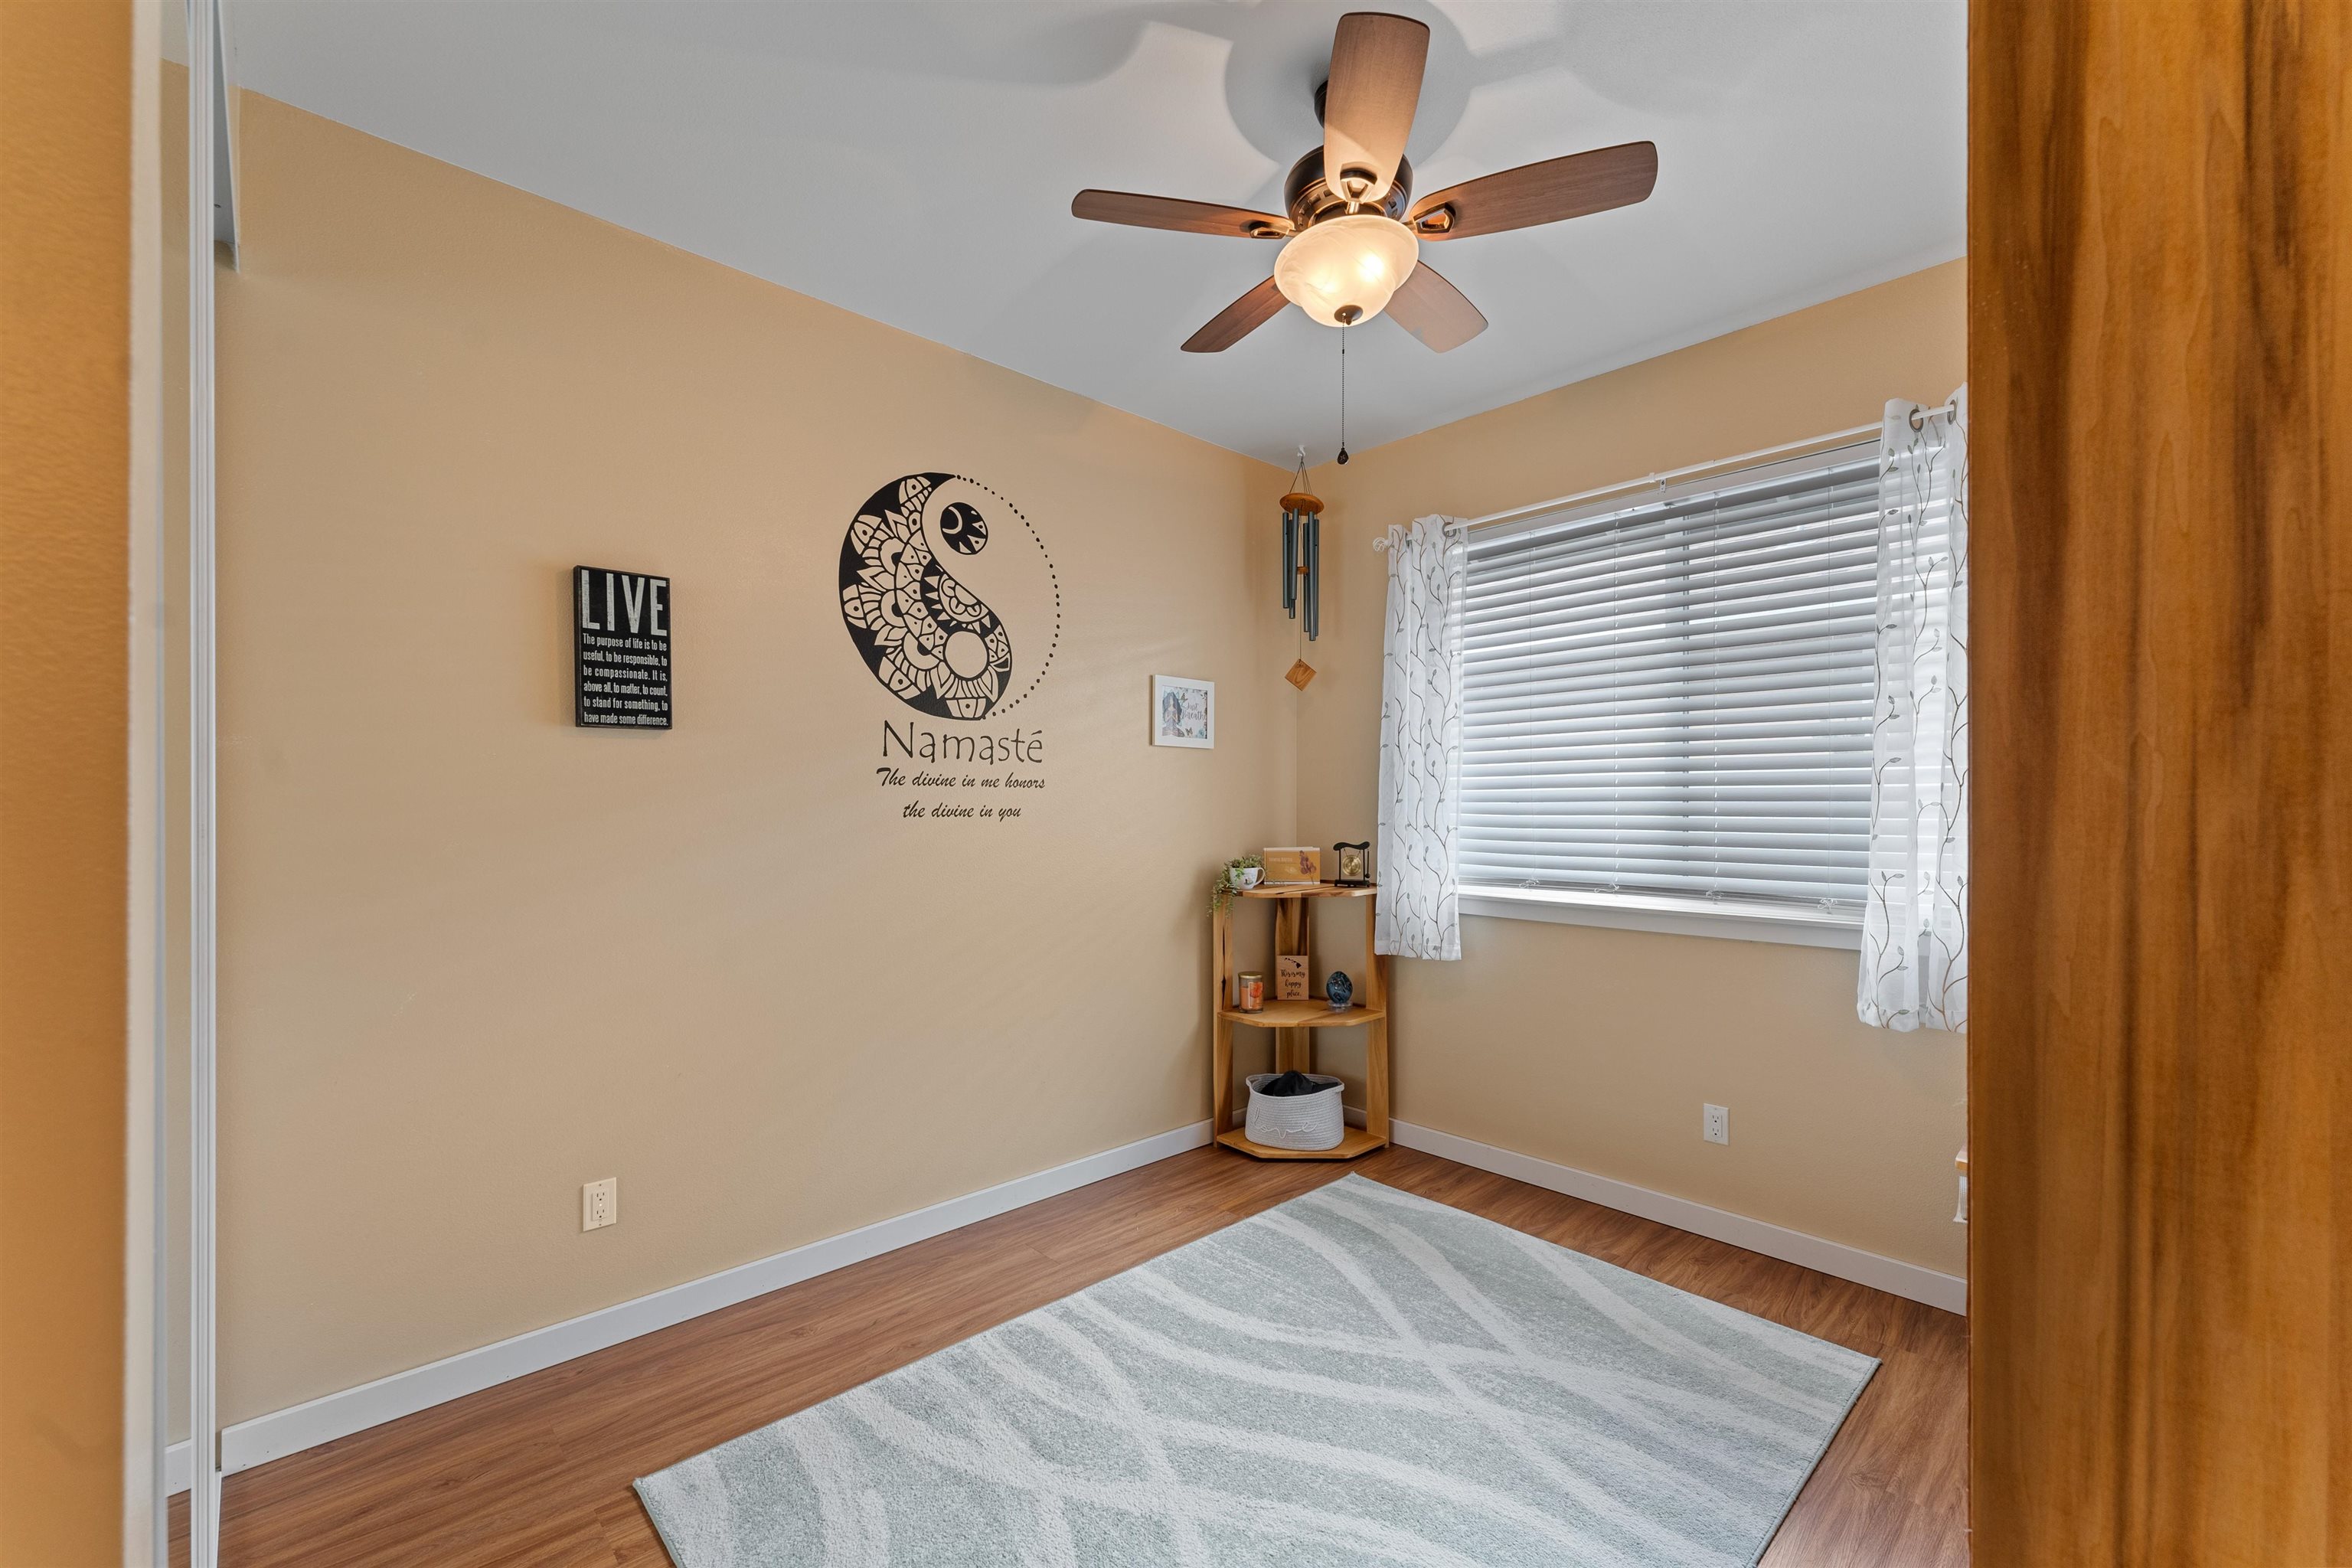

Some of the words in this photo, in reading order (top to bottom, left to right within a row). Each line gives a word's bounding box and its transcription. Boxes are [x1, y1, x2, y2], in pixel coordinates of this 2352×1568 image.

[581, 569, 668, 636] LIVE
[583, 633, 595, 645] The
[596, 637, 623, 648] purpose
[625, 638, 632, 648] of
[632, 638, 642, 648] life
[644, 639, 650, 649] is
[652, 639, 658, 650] to
[659, 640, 667, 651] be
[606, 651, 612, 662] to
[614, 652, 622, 662] be
[662, 656, 668, 666] to
[583, 665, 592, 676] be
[595, 668, 650, 680] compassionate.
[652, 670, 658, 680] It
[583, 681, 602, 692] above
[613, 682, 619, 693] to
[642, 684, 648, 694] to
[584, 696, 590, 707] to
[593, 697, 611, 707] stand
[613, 698, 622, 708] for
[662, 701, 668, 710] to
[1186, 702, 1199, 710] Just
[584, 712, 599, 723] have
[600, 713, 618, 724] made
[637, 714, 668, 726] difference.
[883, 720, 1043, 765] Namasté
[876, 767, 906, 786] The
[912, 770, 956, 787] divine
[962, 774, 976, 787] in
[981, 776, 999, 788] me
[1004, 772, 1046, 789] honors
[903, 800, 926, 818] the
[931, 802, 974, 818] divine
[980, 805, 993, 818] in
[998, 806, 1022, 822] you
[1285, 979, 1302, 988] happy
